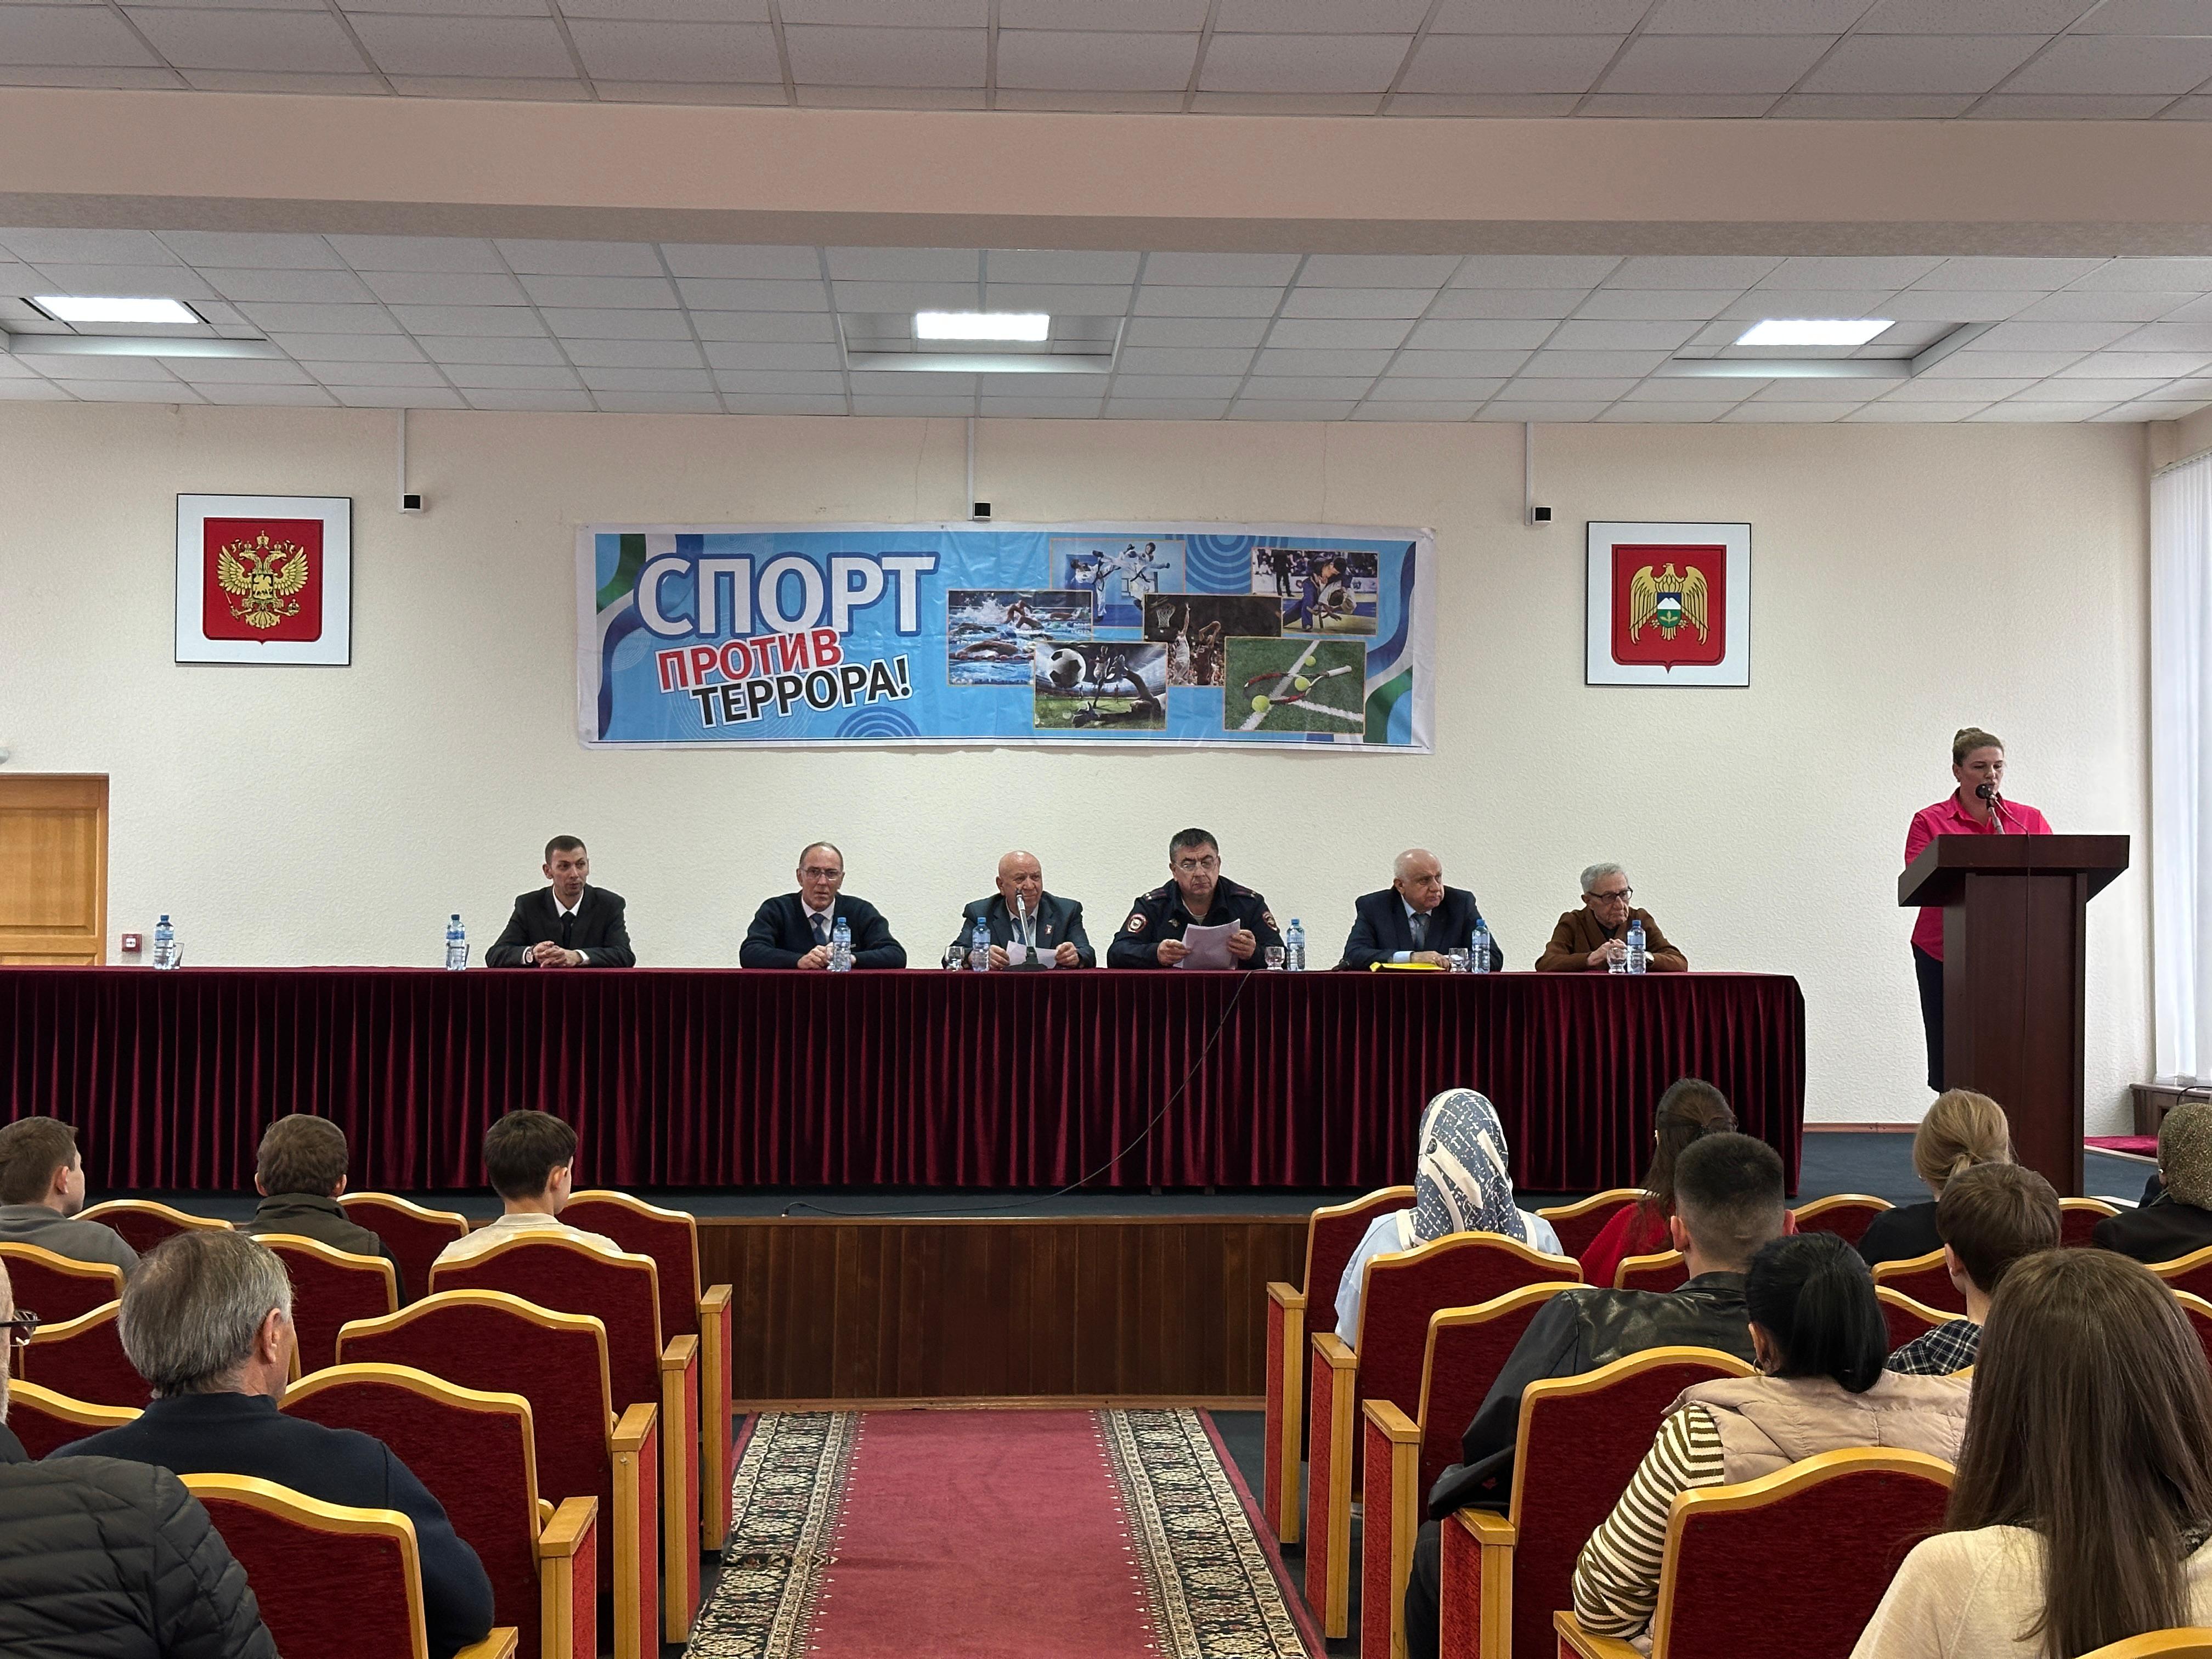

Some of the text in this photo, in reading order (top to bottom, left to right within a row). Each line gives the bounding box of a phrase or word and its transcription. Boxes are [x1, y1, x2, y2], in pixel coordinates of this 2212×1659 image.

[636, 555, 938, 636] СПОРТ
[658, 629, 842, 690] ПРОТИВ
[691, 657, 912, 727] ТЕРРОРА!
